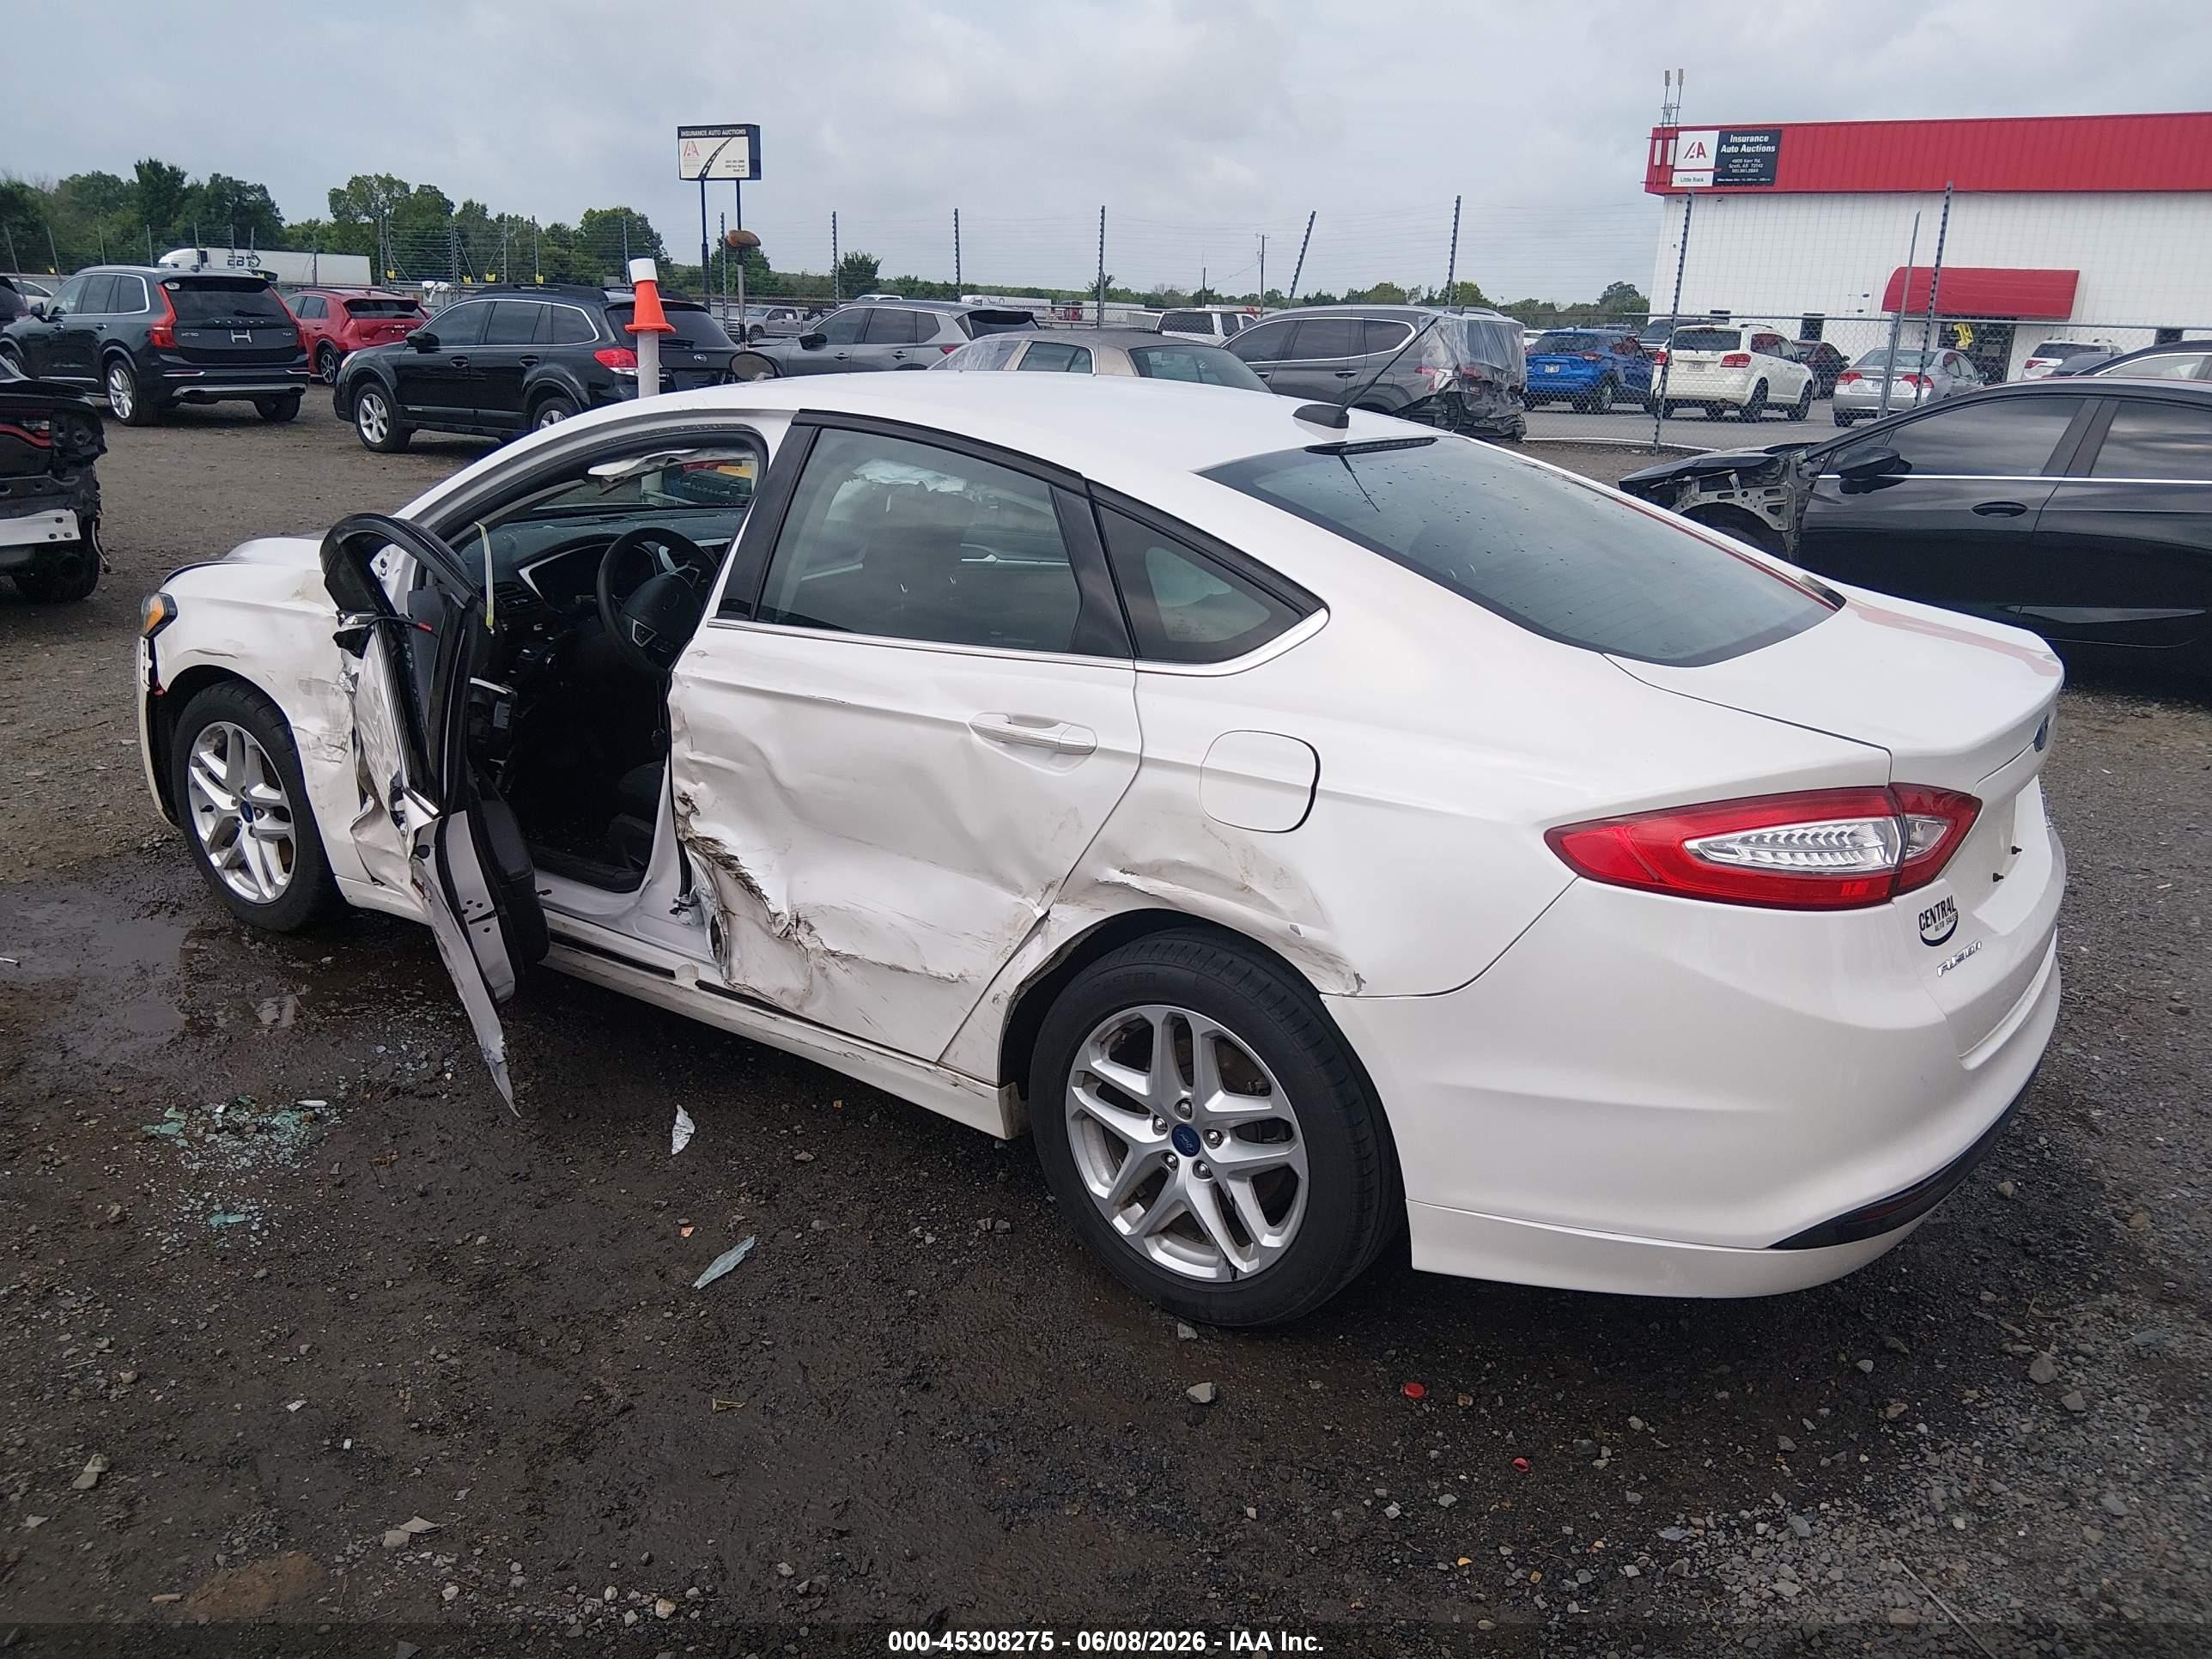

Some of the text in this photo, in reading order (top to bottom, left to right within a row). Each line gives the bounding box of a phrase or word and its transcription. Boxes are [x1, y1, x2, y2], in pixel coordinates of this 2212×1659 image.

[1729, 134, 1770, 143] Insurance
[1720, 143, 1776, 154] Auto Auctions
[1919, 895, 1956, 932] CENTRAL
